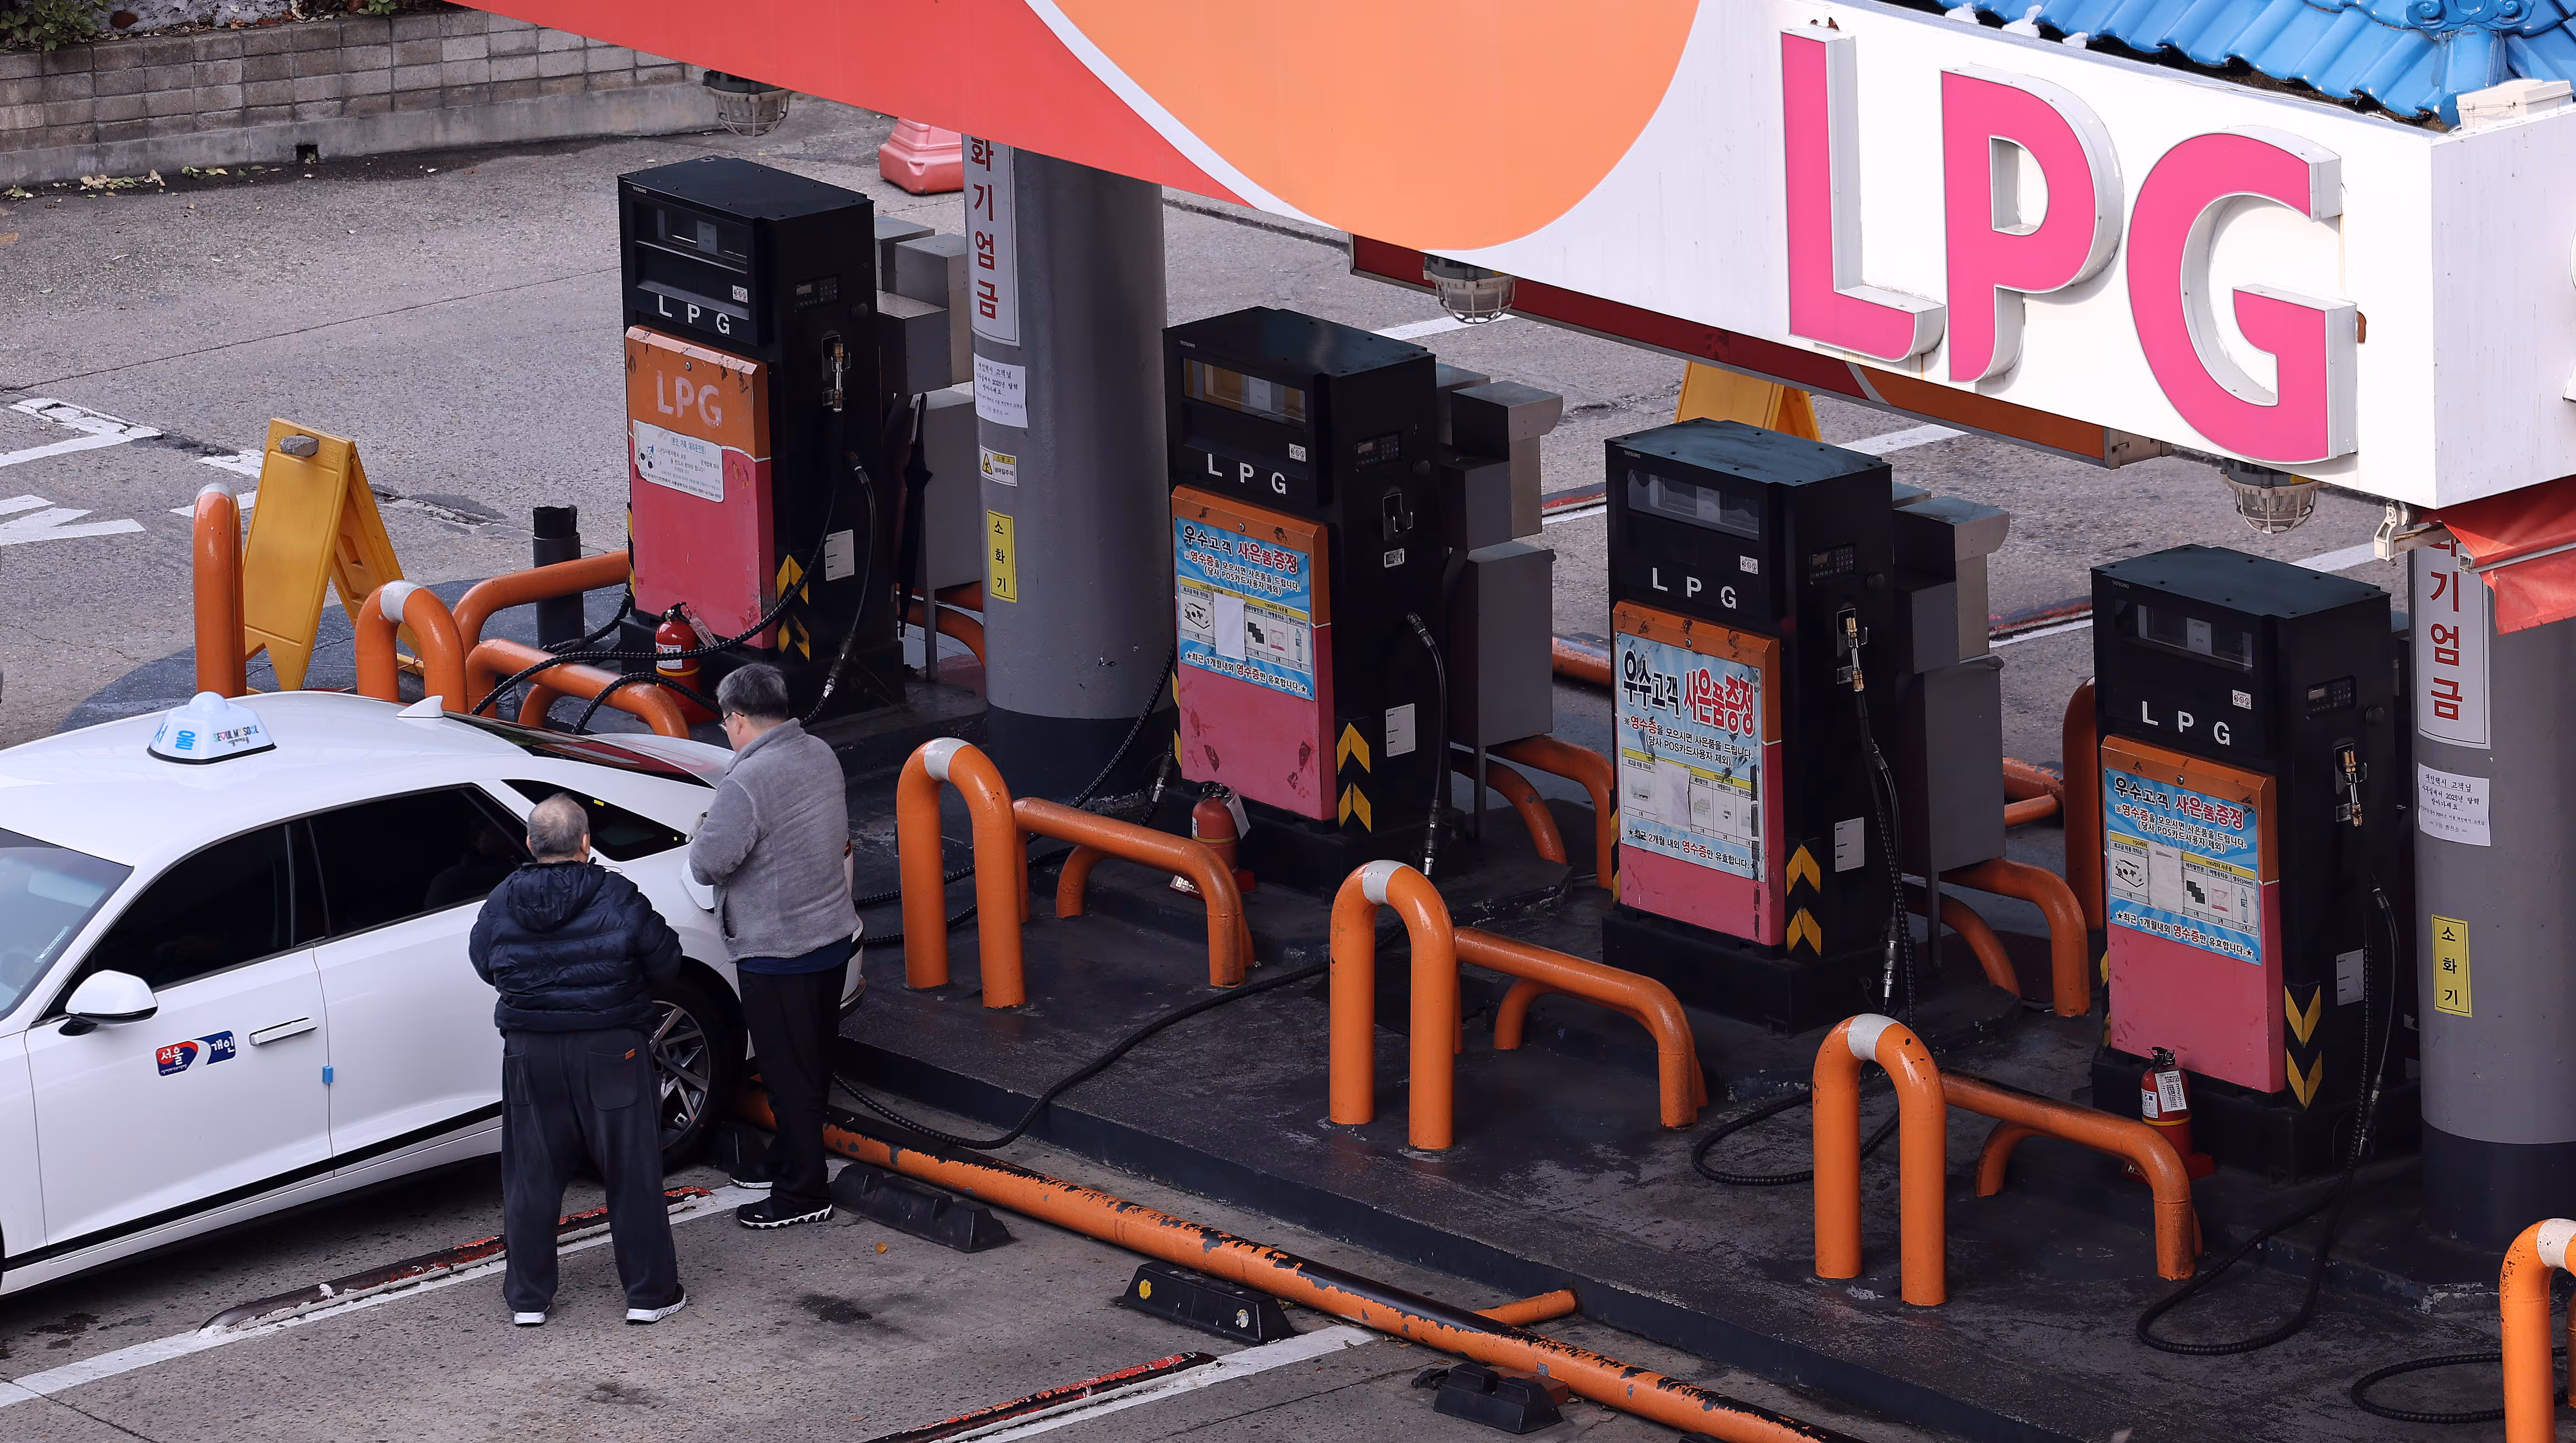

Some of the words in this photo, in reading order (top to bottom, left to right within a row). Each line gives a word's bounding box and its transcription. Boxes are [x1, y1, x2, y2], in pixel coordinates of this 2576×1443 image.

[971, 136, 999, 320] 화기엄금
[1780, 29, 2357, 464] LPG
[657, 370, 722, 428] LPG
[994, 520, 1006, 593] 소화기
[1183, 525, 1233, 556] 우수고객
[1238, 541, 1298, 574] 사은품증정
[1204, 566, 1219, 577] (당사
[1222, 571, 1265, 592] POS카드사용자
[1266, 584, 1282, 596] 제외)
[1222, 563, 1246, 575] 모으시면
[1248, 569, 1271, 583] 사은품을
[1274, 577, 1301, 592] 드립니다.
[2429, 544, 2463, 721] 기엄금
[1237, 663, 1266, 682] 영수증만
[1623, 651, 1680, 717] 우수고객
[1684, 668, 1754, 736] 사은품증정
[1646, 734, 1662, 748] (당사
[1664, 741, 1713, 762] POS카드사용자
[1715, 754, 1731, 767] 제외)
[1666, 729, 1692, 744] 모으시면
[1695, 736, 1722, 751] 사은품을
[1725, 744, 1753, 760] 드립니다.
[2115, 776, 2169, 809] 우수고객
[2175, 795, 2243, 830] 사은품증정
[2451, 782, 2471, 792] 고객님
[1648, 833, 1665, 846] 2개월
[1682, 840, 1713, 859] 영수증만
[2138, 821, 2155, 833] (당사
[2157, 826, 2206, 847] POS카드사용자
[2208, 840, 2225, 853] 제외)
[2158, 816, 2185, 829] 모으시면
[2188, 824, 2215, 839] 사은품을
[2217, 833, 2247, 849] 드립니다.
[2205, 860, 2220, 869] 100리터
[2139, 918, 2170, 935] 1개월내외
[2173, 925, 2206, 945] 영수증만
[2441, 926, 2457, 1006] 소화기
[161, 1046, 184, 1065] 서울
[211, 1036, 235, 1053] 개인
